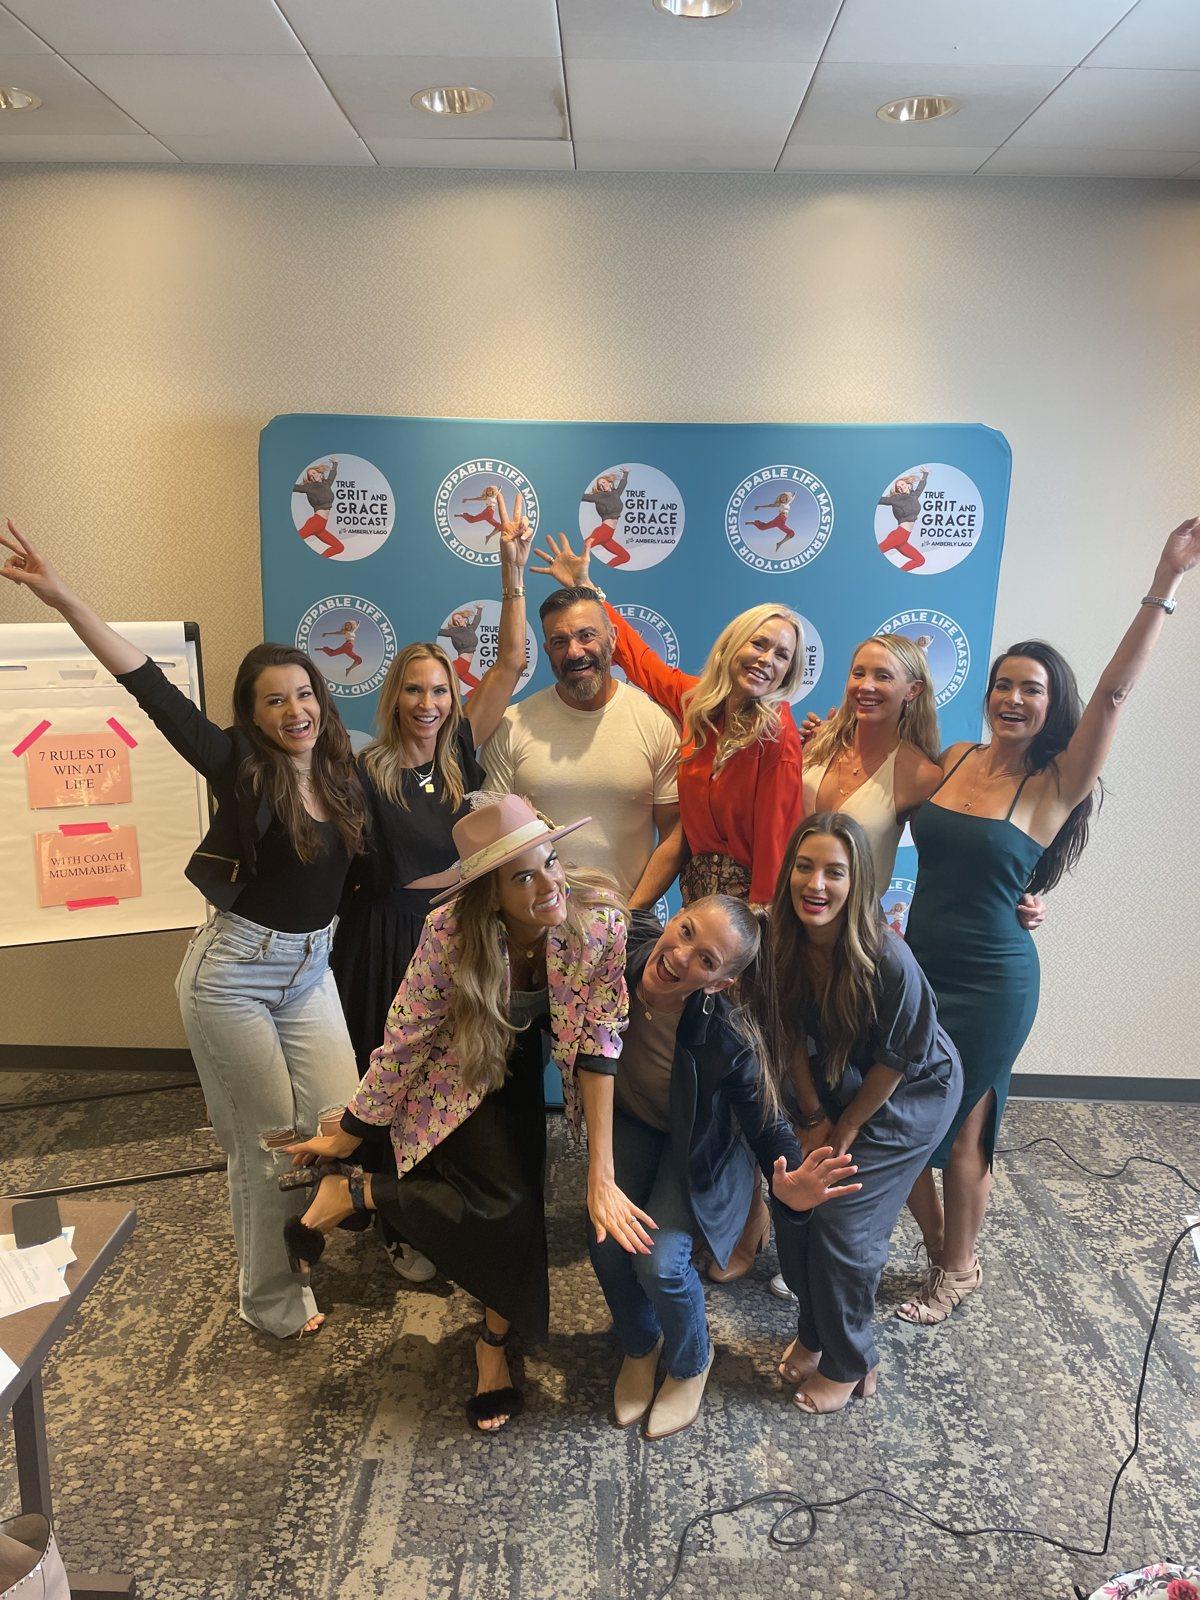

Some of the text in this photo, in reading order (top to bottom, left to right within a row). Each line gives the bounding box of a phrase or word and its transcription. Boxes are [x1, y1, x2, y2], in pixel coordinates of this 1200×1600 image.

[497, 464, 525, 487] LIFE
[336, 480, 356, 488] TRUE
[335, 489, 368, 501] GRIT
[437, 461, 493, 537] UNSTOPPABLE
[625, 490, 646, 498] TRUE
[924, 491, 945, 499] TRUE
[336, 502, 388, 515] GRACE
[624, 499, 678, 511] GRIT AND
[922, 500, 977, 513] GRIT AND
[336, 516, 388, 526] PODCAST
[624, 512, 678, 525] GRACE
[728, 468, 831, 570] YOUR UNSTOPPABLE LIFE MASTERMIND
[921, 513, 976, 527] GRACE
[624, 525, 677, 536] PODCAST
[920, 528, 975, 538] PODCAST
[449, 537, 484, 563] YOUR
[355, 600, 382, 622] LIFE
[638, 609, 666, 631] LIFE
[931, 614, 958, 637] LIFE
[480, 625, 499, 633] TRUE
[39, 748, 116, 761] 7 RULES TO
[54, 763, 104, 775] WIN AT
[65, 779, 95, 790] LIFE
[51, 851, 124, 866] WITH COACH
[49, 863, 128, 879] MUMMABEAR
